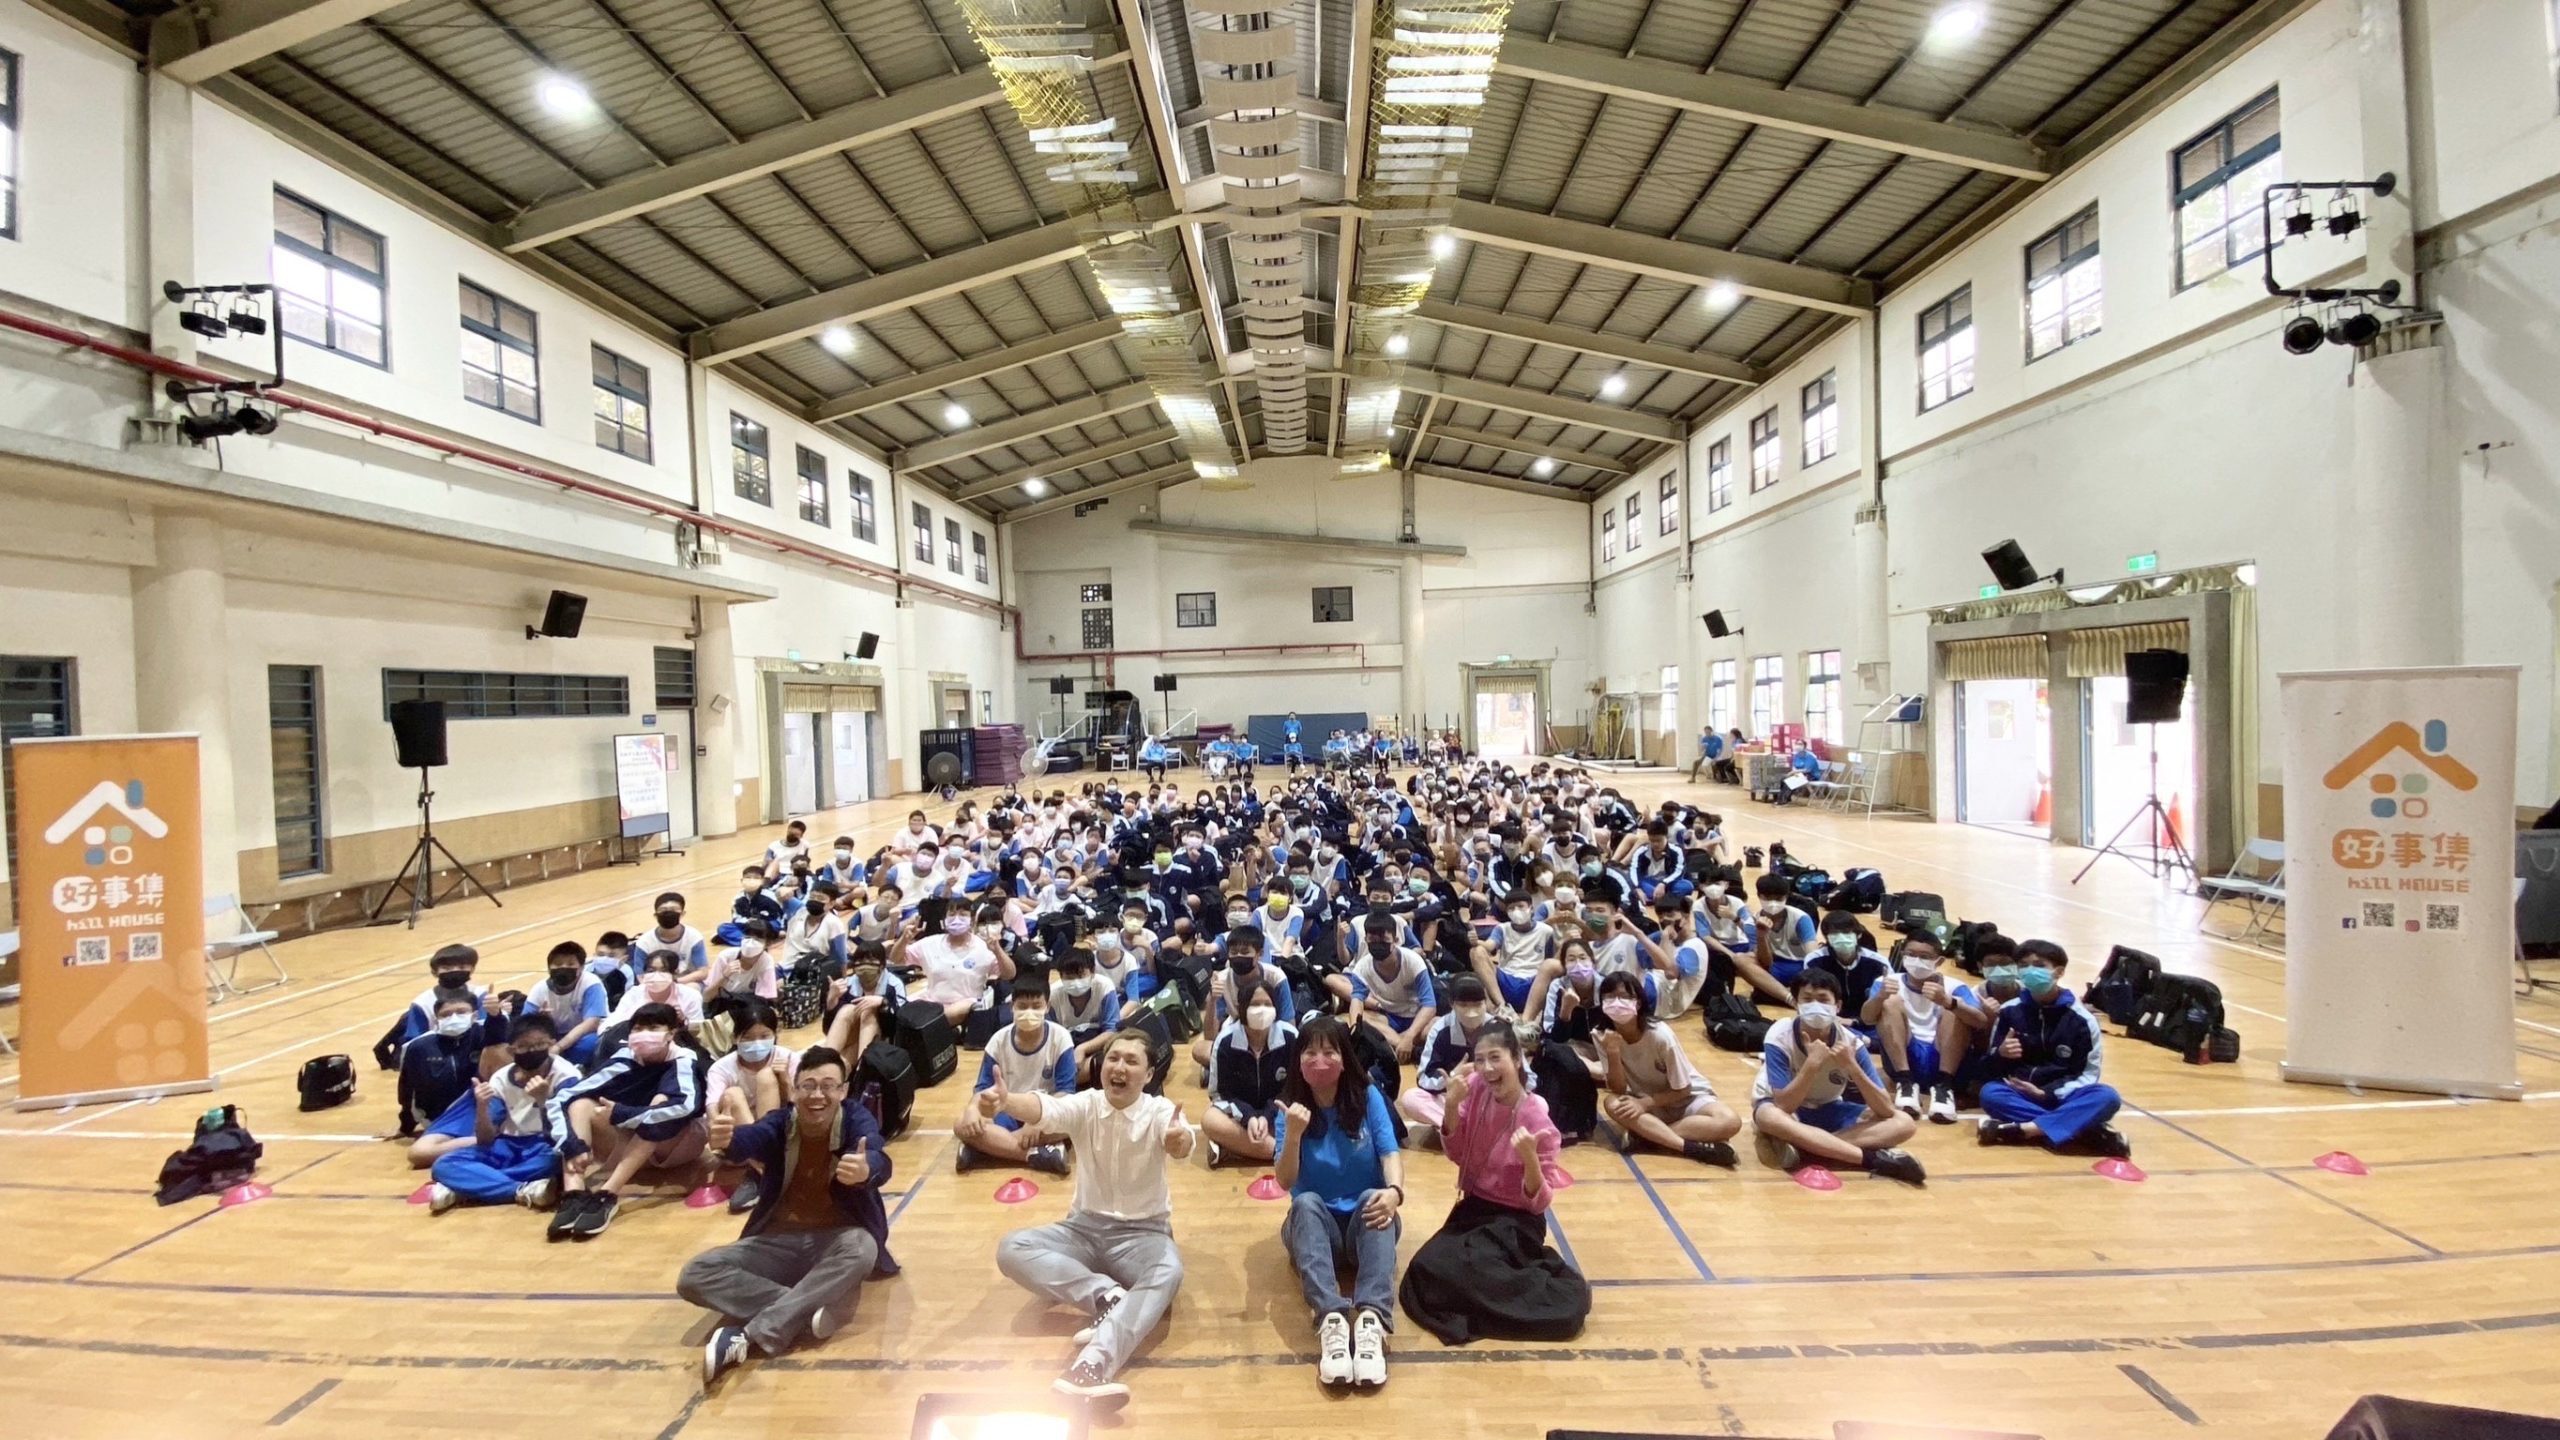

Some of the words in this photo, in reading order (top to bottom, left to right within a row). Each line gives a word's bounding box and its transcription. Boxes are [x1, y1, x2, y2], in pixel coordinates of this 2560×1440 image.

[2332, 828, 2470, 872] 好事集
[53, 872, 165, 913] 好事集
[2398, 878, 2470, 893] HOUSE
[109, 912, 165, 928] HOUSE
